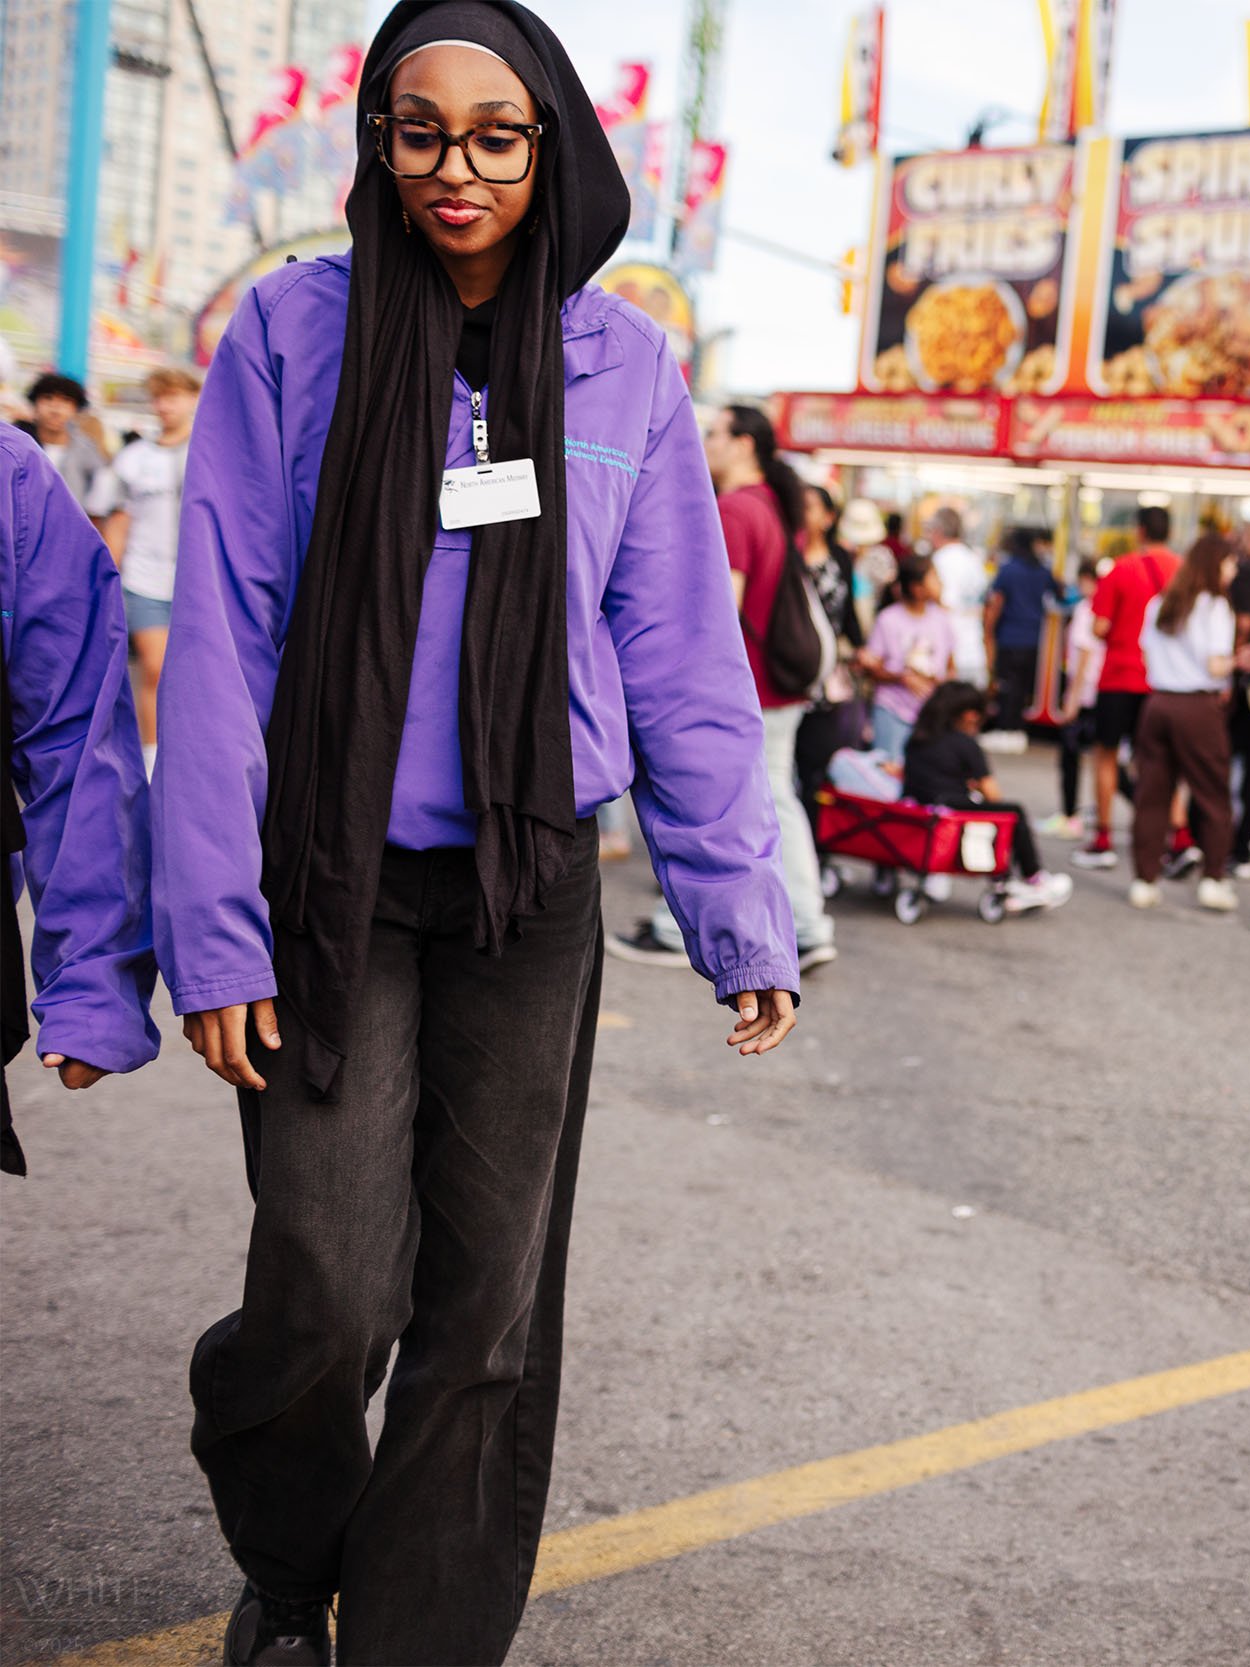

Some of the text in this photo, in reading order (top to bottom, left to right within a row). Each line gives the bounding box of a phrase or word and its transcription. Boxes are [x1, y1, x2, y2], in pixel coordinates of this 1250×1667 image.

[905, 149, 1072, 212] CURLY
[904, 217, 1060, 275] FRIES
[565, 438, 588, 449] North
